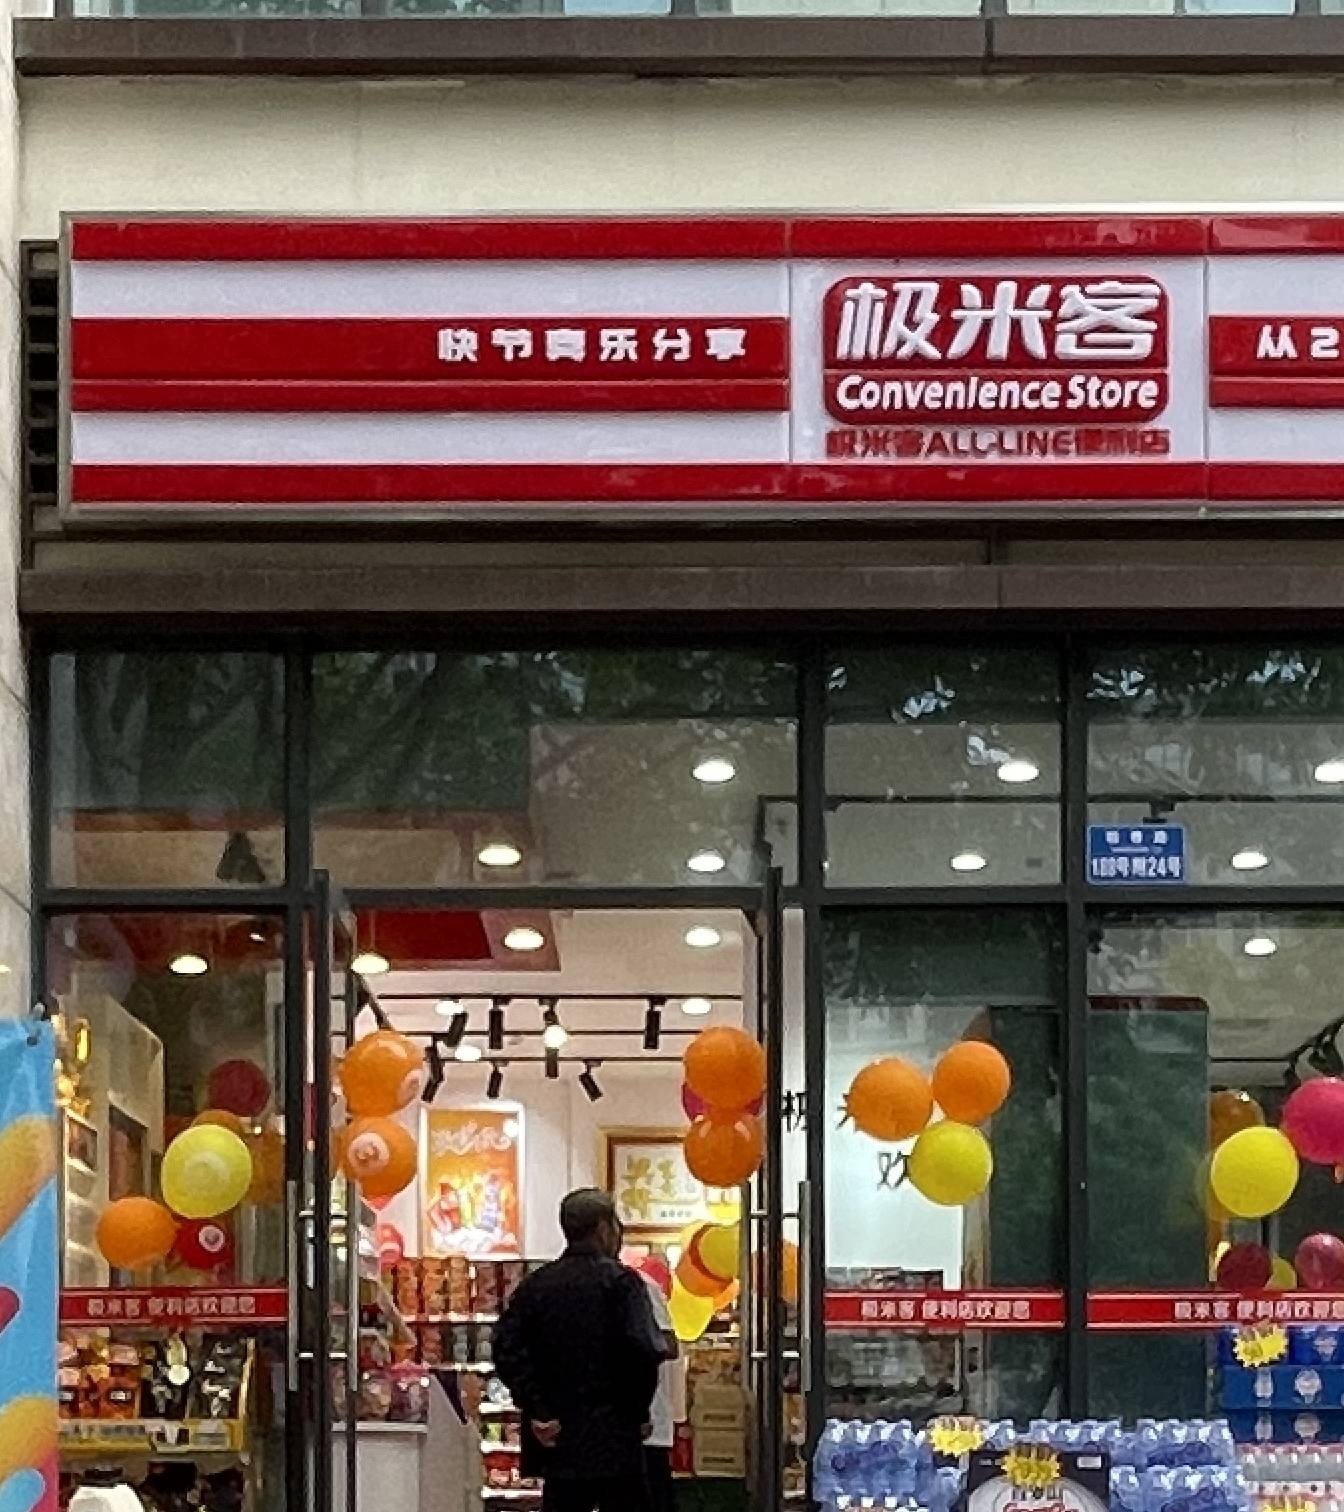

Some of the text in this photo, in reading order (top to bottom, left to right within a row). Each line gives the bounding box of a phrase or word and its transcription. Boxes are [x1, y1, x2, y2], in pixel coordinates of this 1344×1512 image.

[836, 281, 1158, 360] 极米客
[836, 374, 1158, 409] Convenience Store
